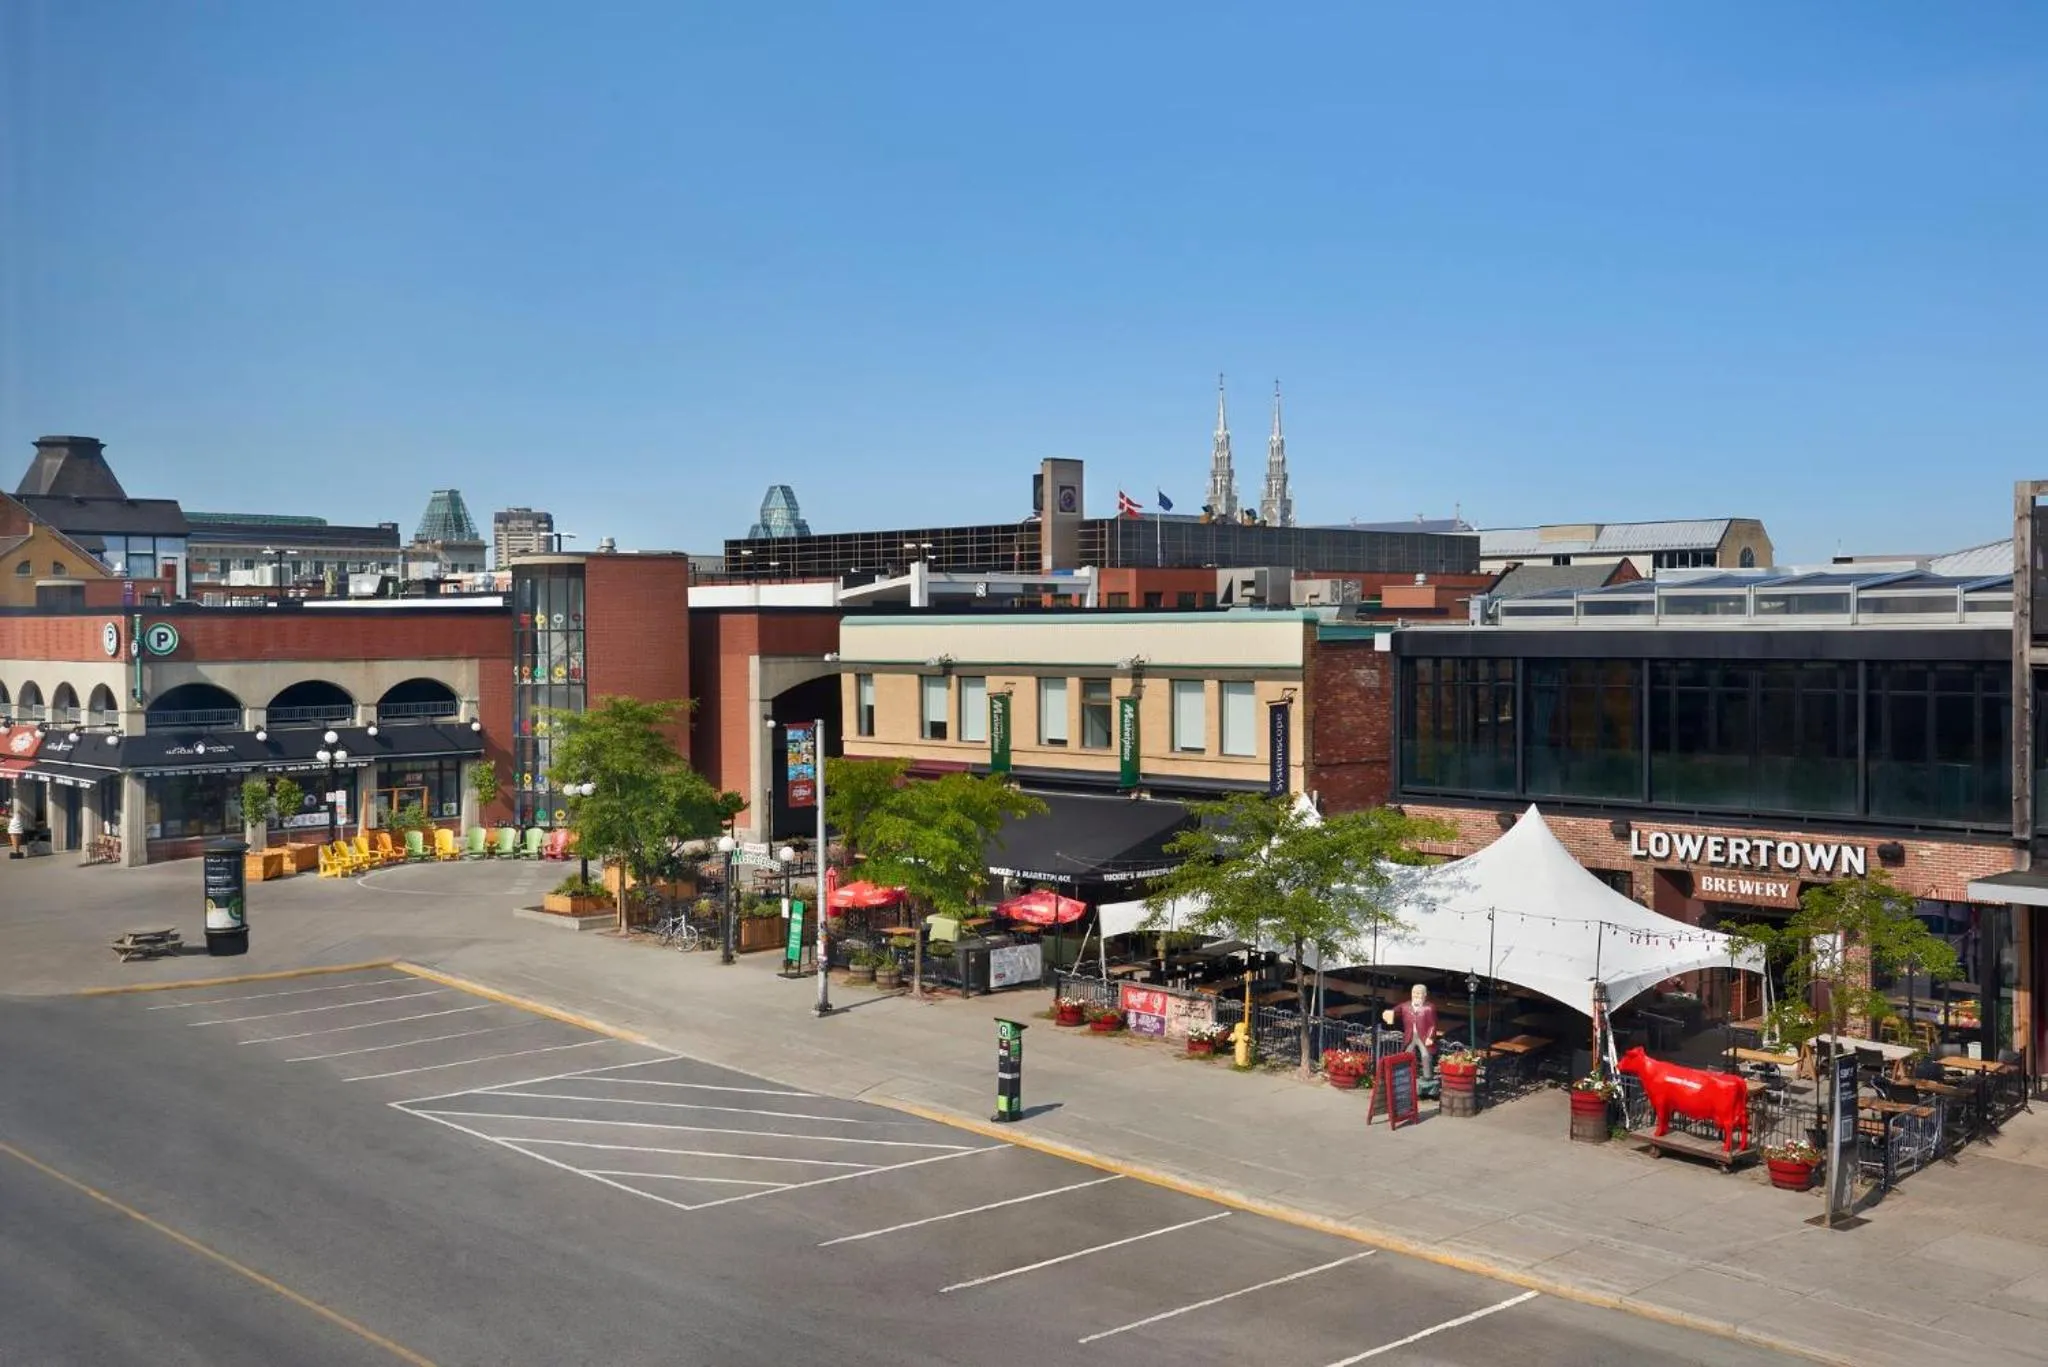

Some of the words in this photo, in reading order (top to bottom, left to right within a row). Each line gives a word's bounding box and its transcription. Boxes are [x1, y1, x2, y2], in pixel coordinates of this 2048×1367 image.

[156, 631, 169, 648] P
[1120, 703, 1134, 761] Marketplace
[1275, 712, 1285, 792] Systemscope
[1630, 829, 1867, 876] LOWERTOWN
[1022, 870, 1072, 883] MARKETPLACE
[1701, 875, 1790, 898] BREWERY
